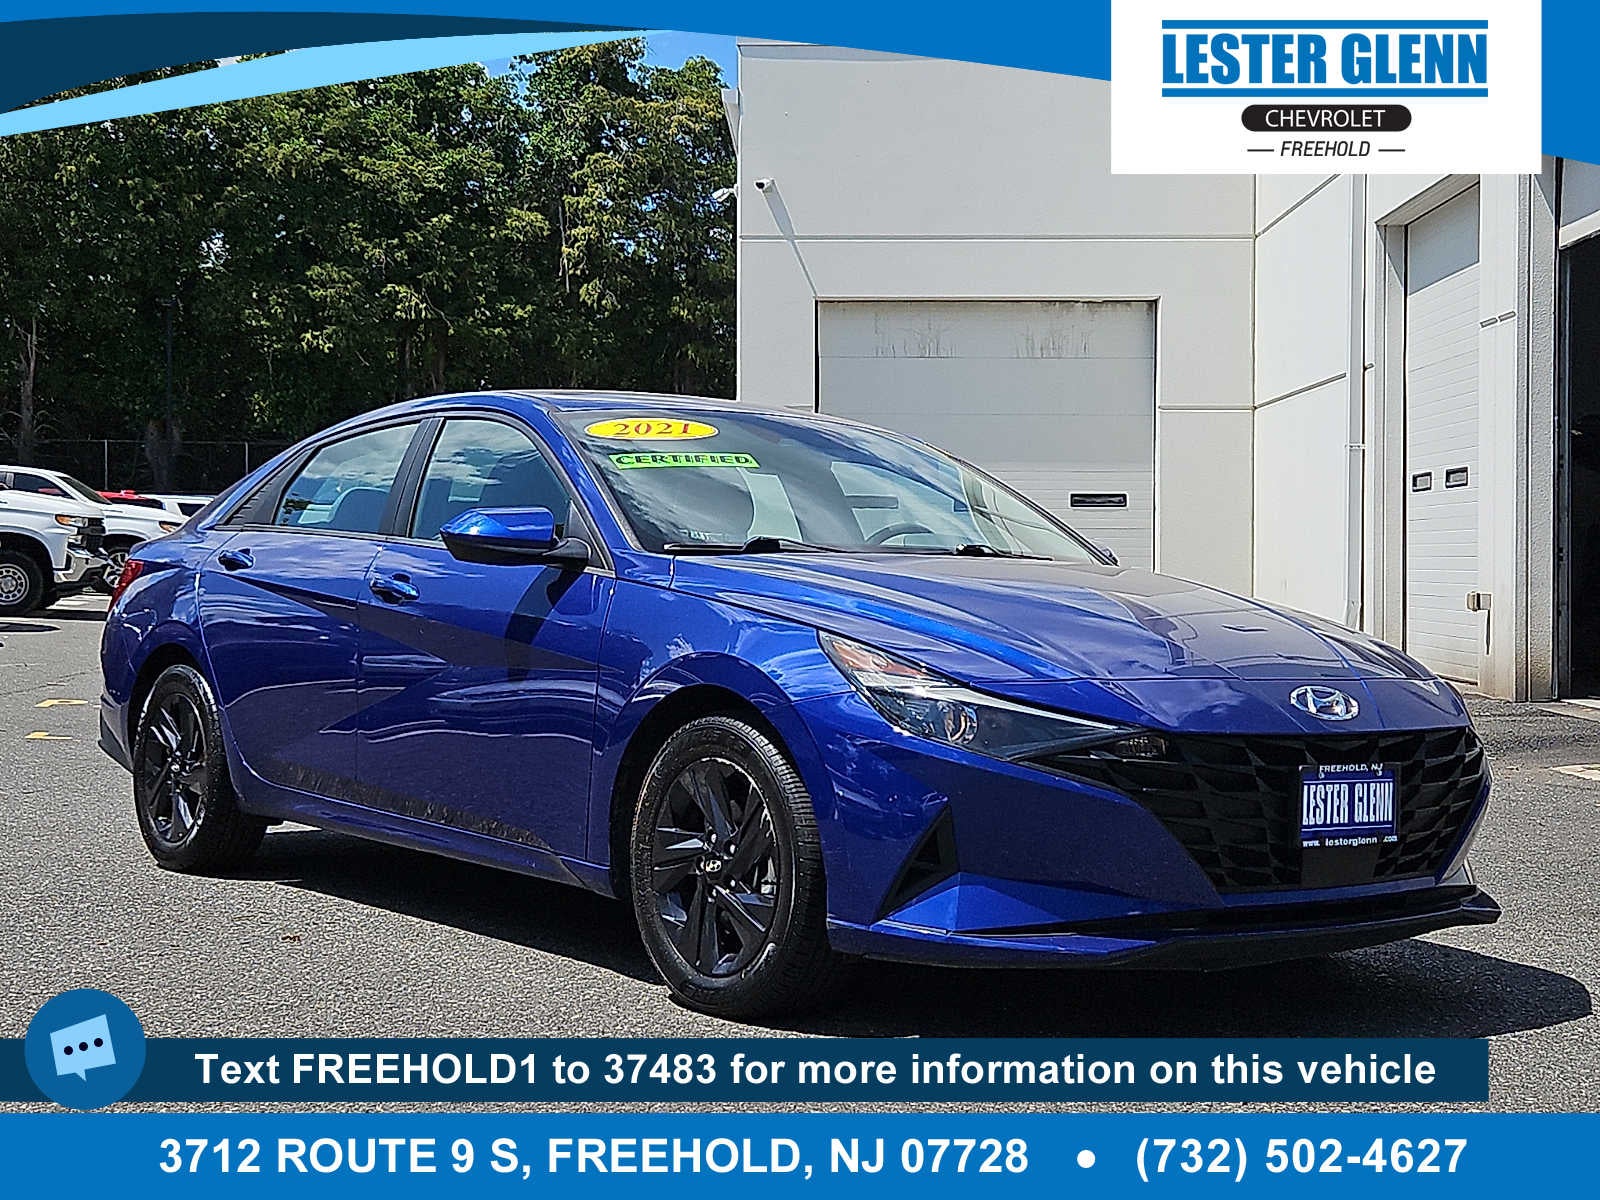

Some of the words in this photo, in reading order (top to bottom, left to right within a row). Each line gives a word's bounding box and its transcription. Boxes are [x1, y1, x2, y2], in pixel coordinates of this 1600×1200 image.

[613, 422, 692, 436] 2021
[615, 453, 751, 466] CERTIFIED
[1319, 763, 1369, 773] FREEHOLD,
[1302, 783, 1349, 826] LESTER
[1354, 782, 1393, 823] GLENN
